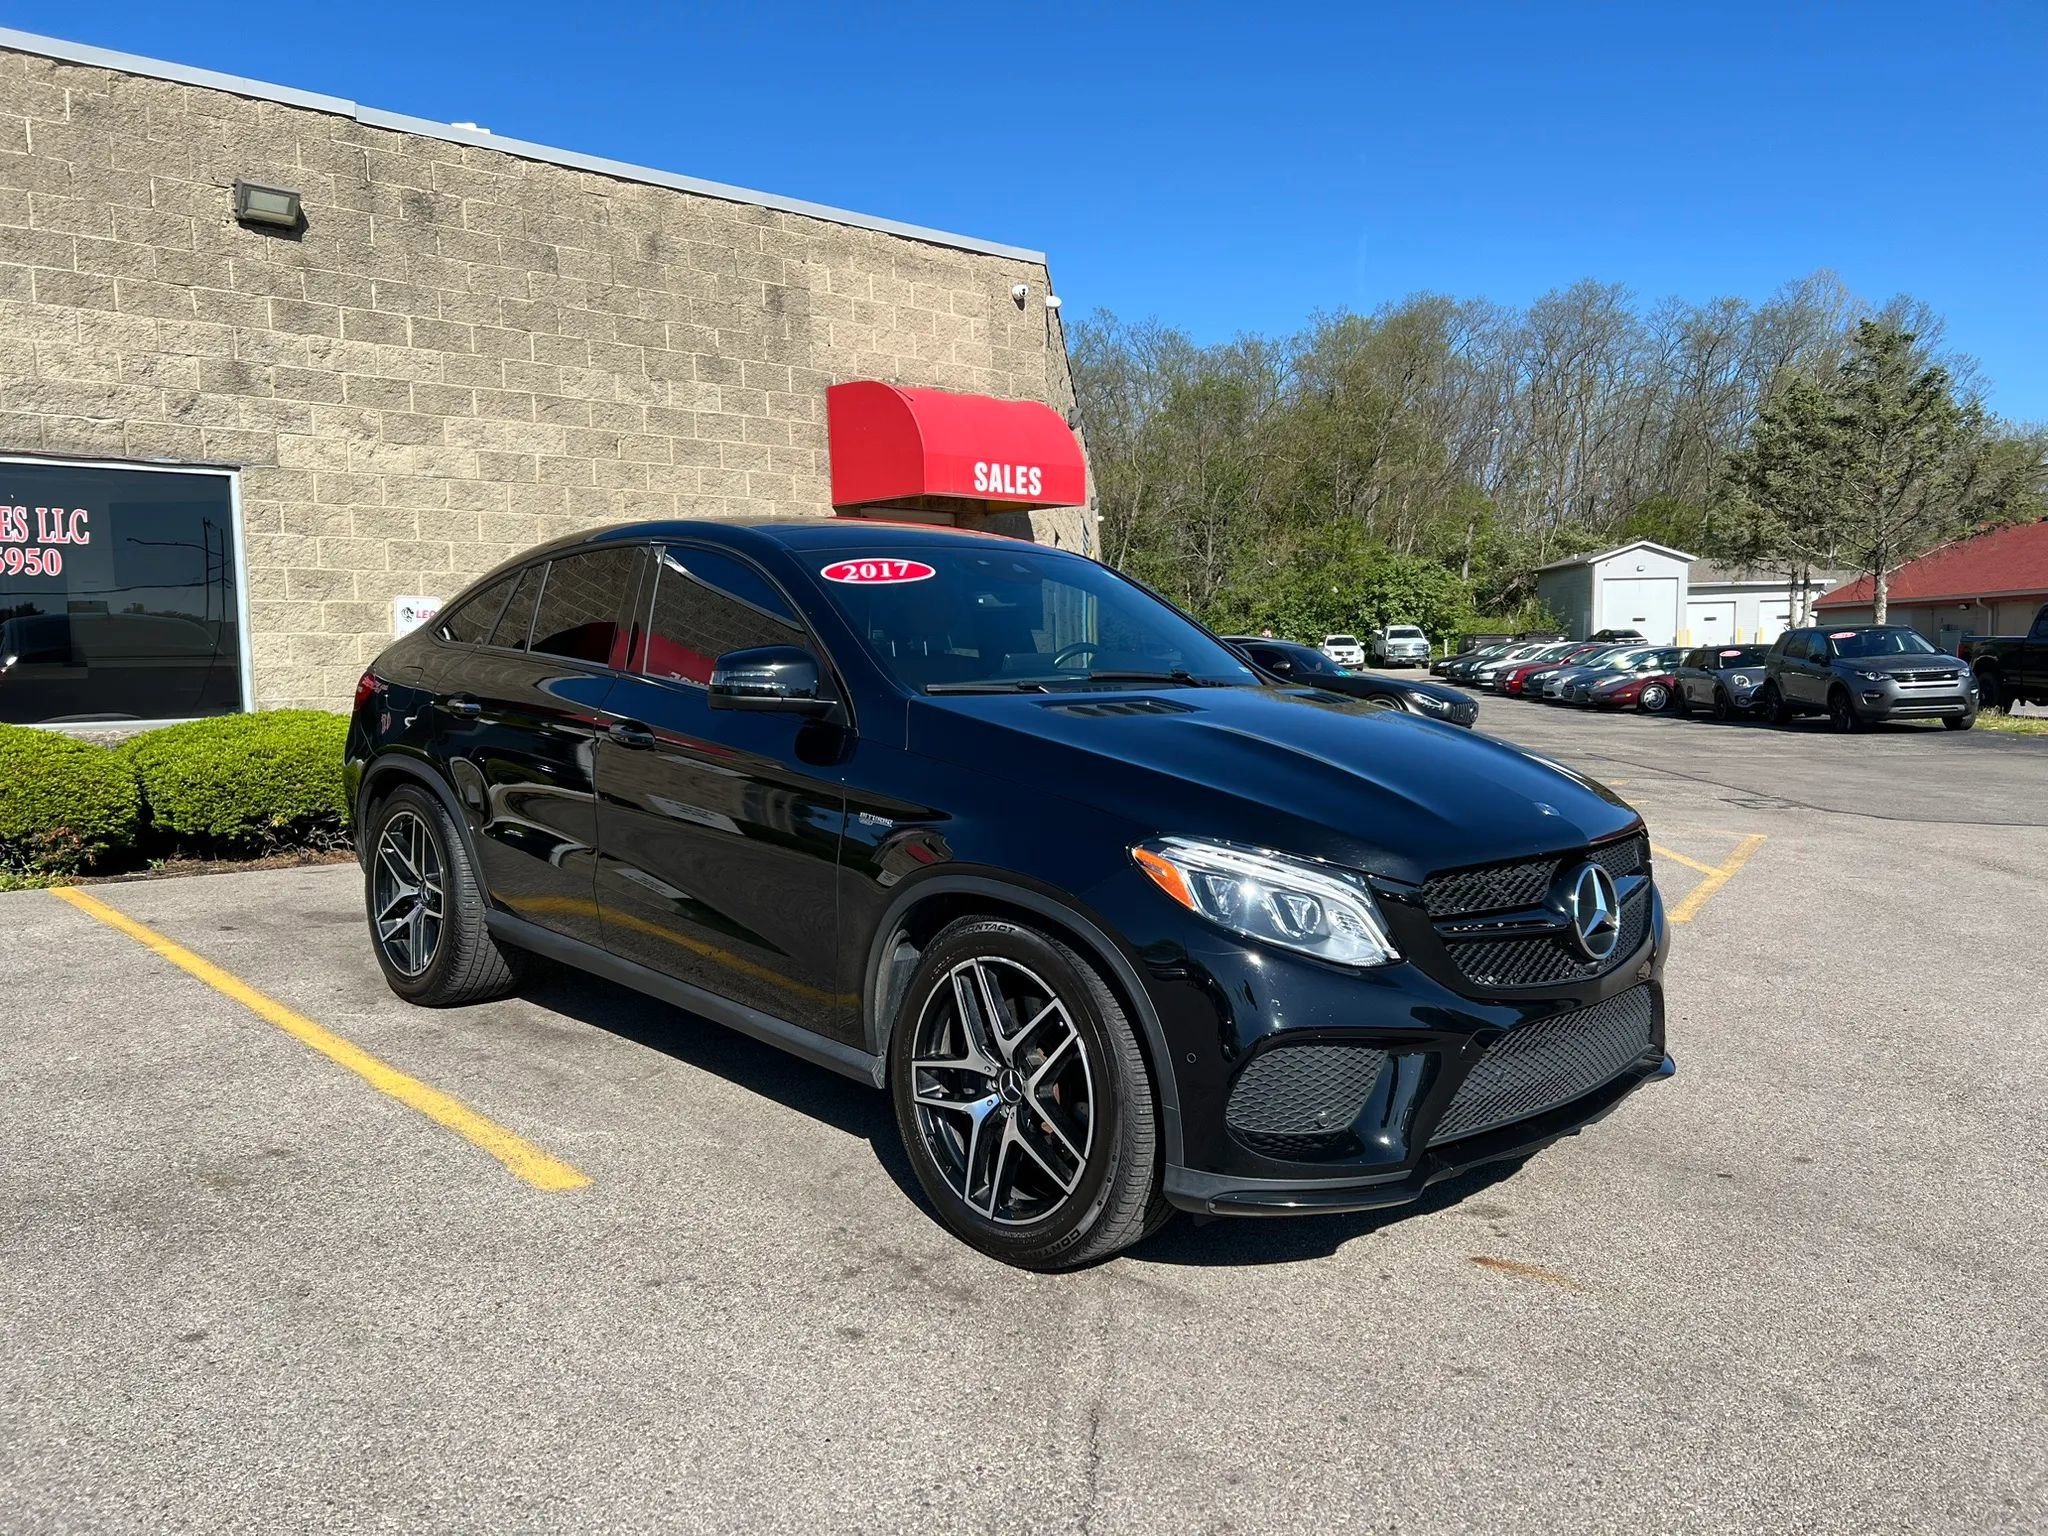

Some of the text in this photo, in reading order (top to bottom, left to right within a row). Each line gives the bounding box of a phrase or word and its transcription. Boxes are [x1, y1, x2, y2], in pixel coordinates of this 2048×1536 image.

[974, 461, 1042, 496] SALES
[35, 507, 90, 545] LLC
[841, 562, 909, 581] 2017
